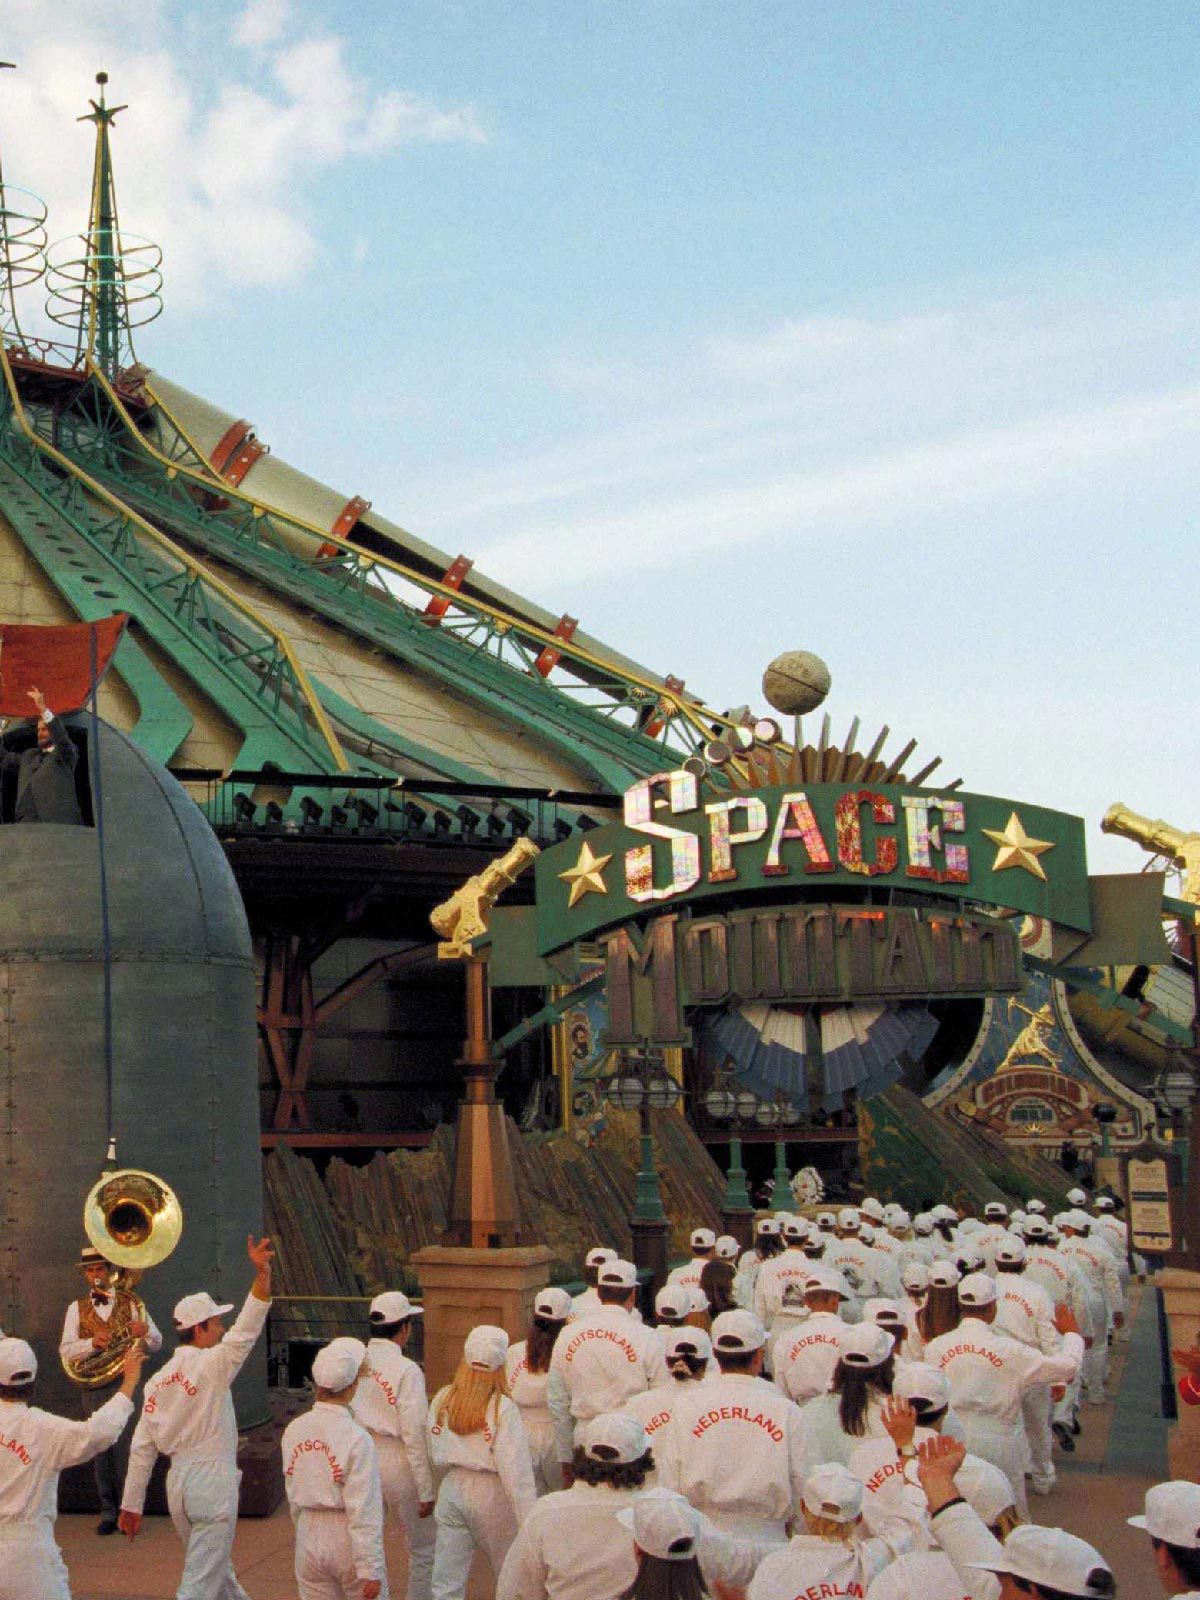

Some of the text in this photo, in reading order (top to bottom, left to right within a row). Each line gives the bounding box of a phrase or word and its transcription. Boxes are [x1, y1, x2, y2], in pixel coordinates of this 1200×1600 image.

[624, 770, 970, 903] SPACE
[600, 905, 1028, 1044] MOUNTAIN
[776, 1269, 809, 1281] FRANC
[565, 1328, 638, 1364] DEUTSCHLAND
[692, 1406, 785, 1445] NEDERLAND
